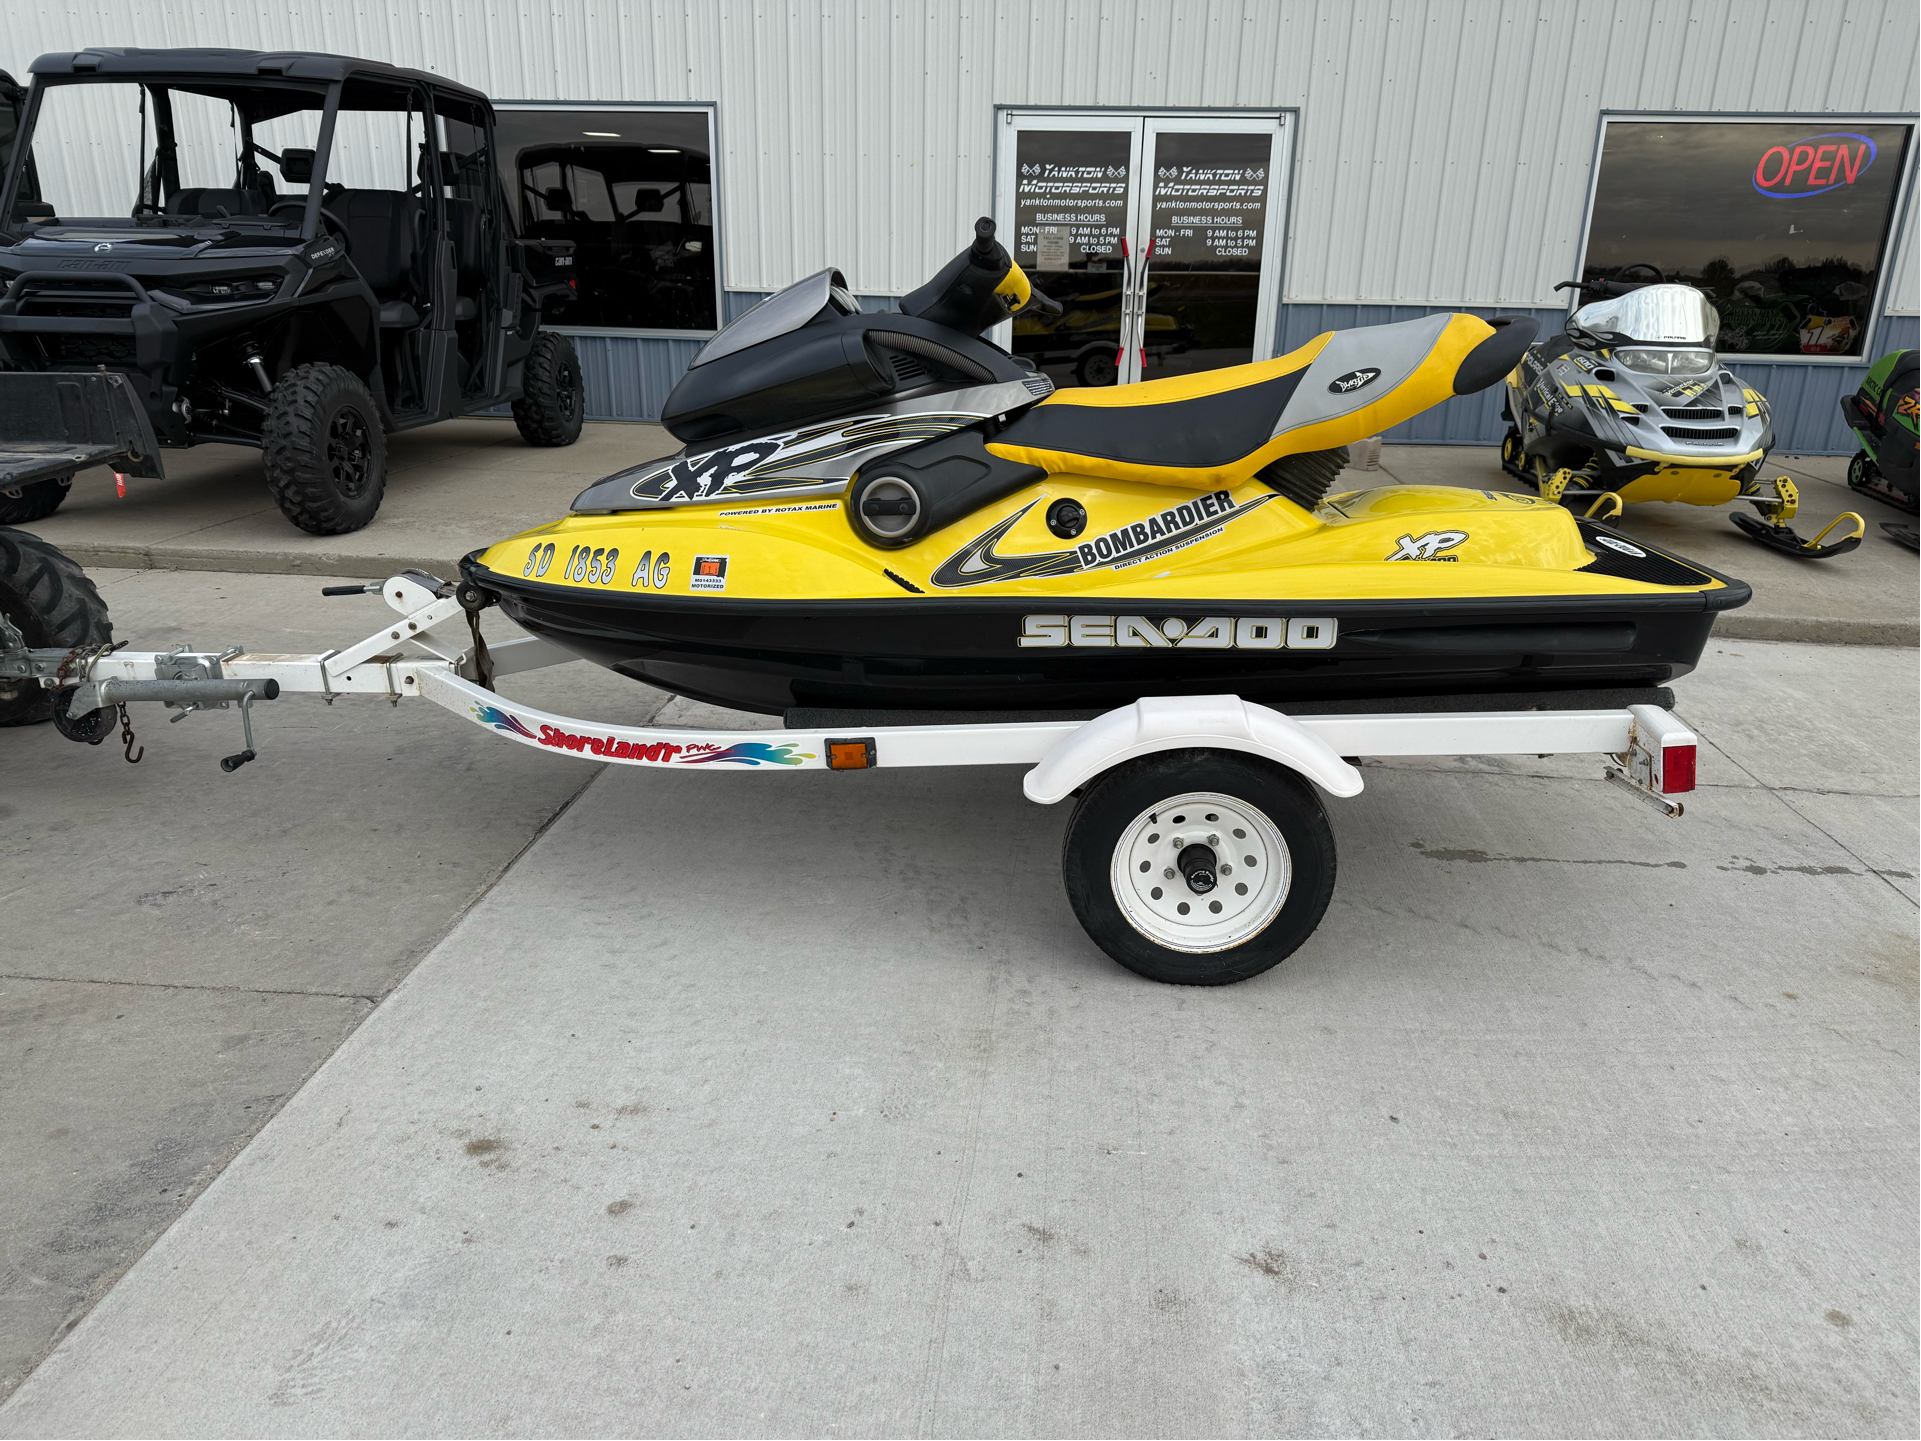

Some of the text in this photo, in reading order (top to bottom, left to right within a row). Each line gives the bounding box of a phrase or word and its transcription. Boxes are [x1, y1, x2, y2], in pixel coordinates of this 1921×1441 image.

[1756, 144, 1866, 187] OPEN
[1020, 198, 1123, 208] yanktonmotorsports.com
[1036, 213, 1106, 222] BUSINESS HOURS
[1156, 200, 1261, 210] yanktonmotorsports.com
[1577, 356, 1594, 369] 600
[658, 442, 784, 501] XP
[1078, 490, 1235, 567] BOMBARDIER
[1114, 527, 1224, 570] DIRECT ACTION SUSPENSION
[1385, 531, 1468, 561] XP
[523, 542, 670, 589] SD 1853 AG
[686, 743, 721, 753] PWC
